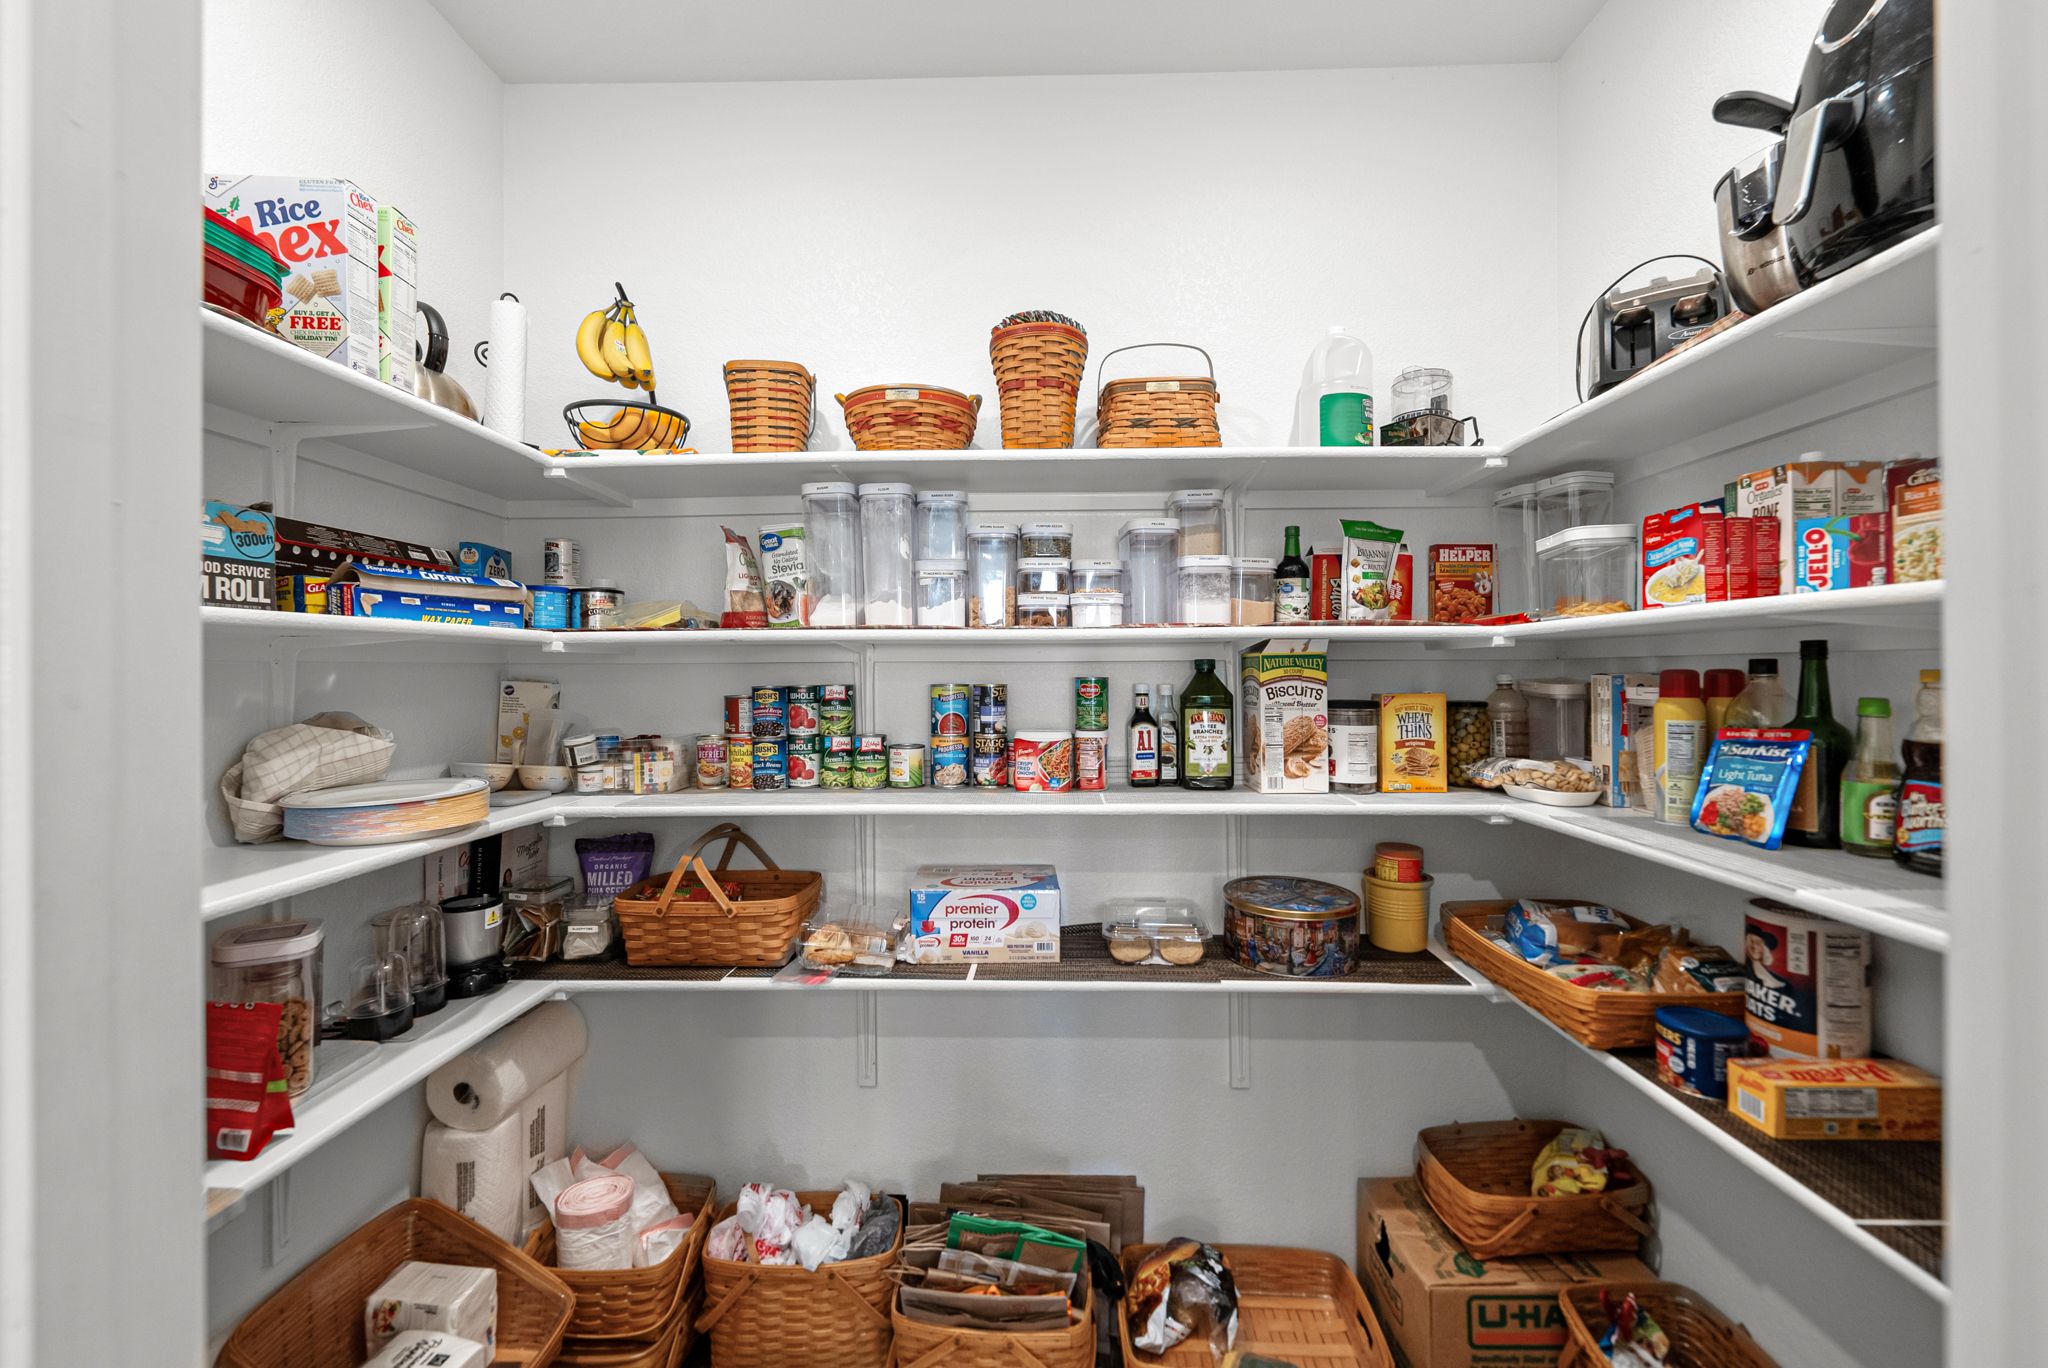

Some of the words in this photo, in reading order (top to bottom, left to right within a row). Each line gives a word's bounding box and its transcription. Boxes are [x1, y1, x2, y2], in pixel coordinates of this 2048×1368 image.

[350, 192, 374, 213] Chex
[254, 198, 322, 228] Rice
[236, 216, 348, 262] hex
[290, 316, 341, 330] FREE
[1747, 487, 1782, 504] Organics
[1842, 492, 1874, 503] Organics
[762, 537, 778, 545] Great
[1440, 549, 1490, 561] HELPER
[224, 564, 271, 579] SERVICE
[489, 565, 506, 578] ZERO
[772, 562, 804, 574] Stevia
[215, 576, 271, 604] ROLL
[307, 584, 326, 593] GLA
[1264, 658, 1295, 670] NATURE
[1295, 658, 1323, 670] VALLEY
[941, 693, 964, 701] PROGRESSO
[992, 688, 1006, 696] STA
[1396, 712, 1432, 724] WHEAT
[938, 744, 963, 753] PROGRESSO
[975, 739, 1004, 748] STAGG
[699, 750, 724, 758] REFRIED
[1728, 744, 1790, 757] StarKist
[1718, 769, 1745, 781] Light
[1747, 770, 1773, 782] Tuna
[588, 871, 633, 886] MILLED
[945, 902, 999, 917] premier
[950, 918, 995, 931] protein
[1746, 977, 1797, 1014] AKER
[1746, 996, 1776, 1021] ATS
[1478, 1304, 1568, 1328] U-HA
